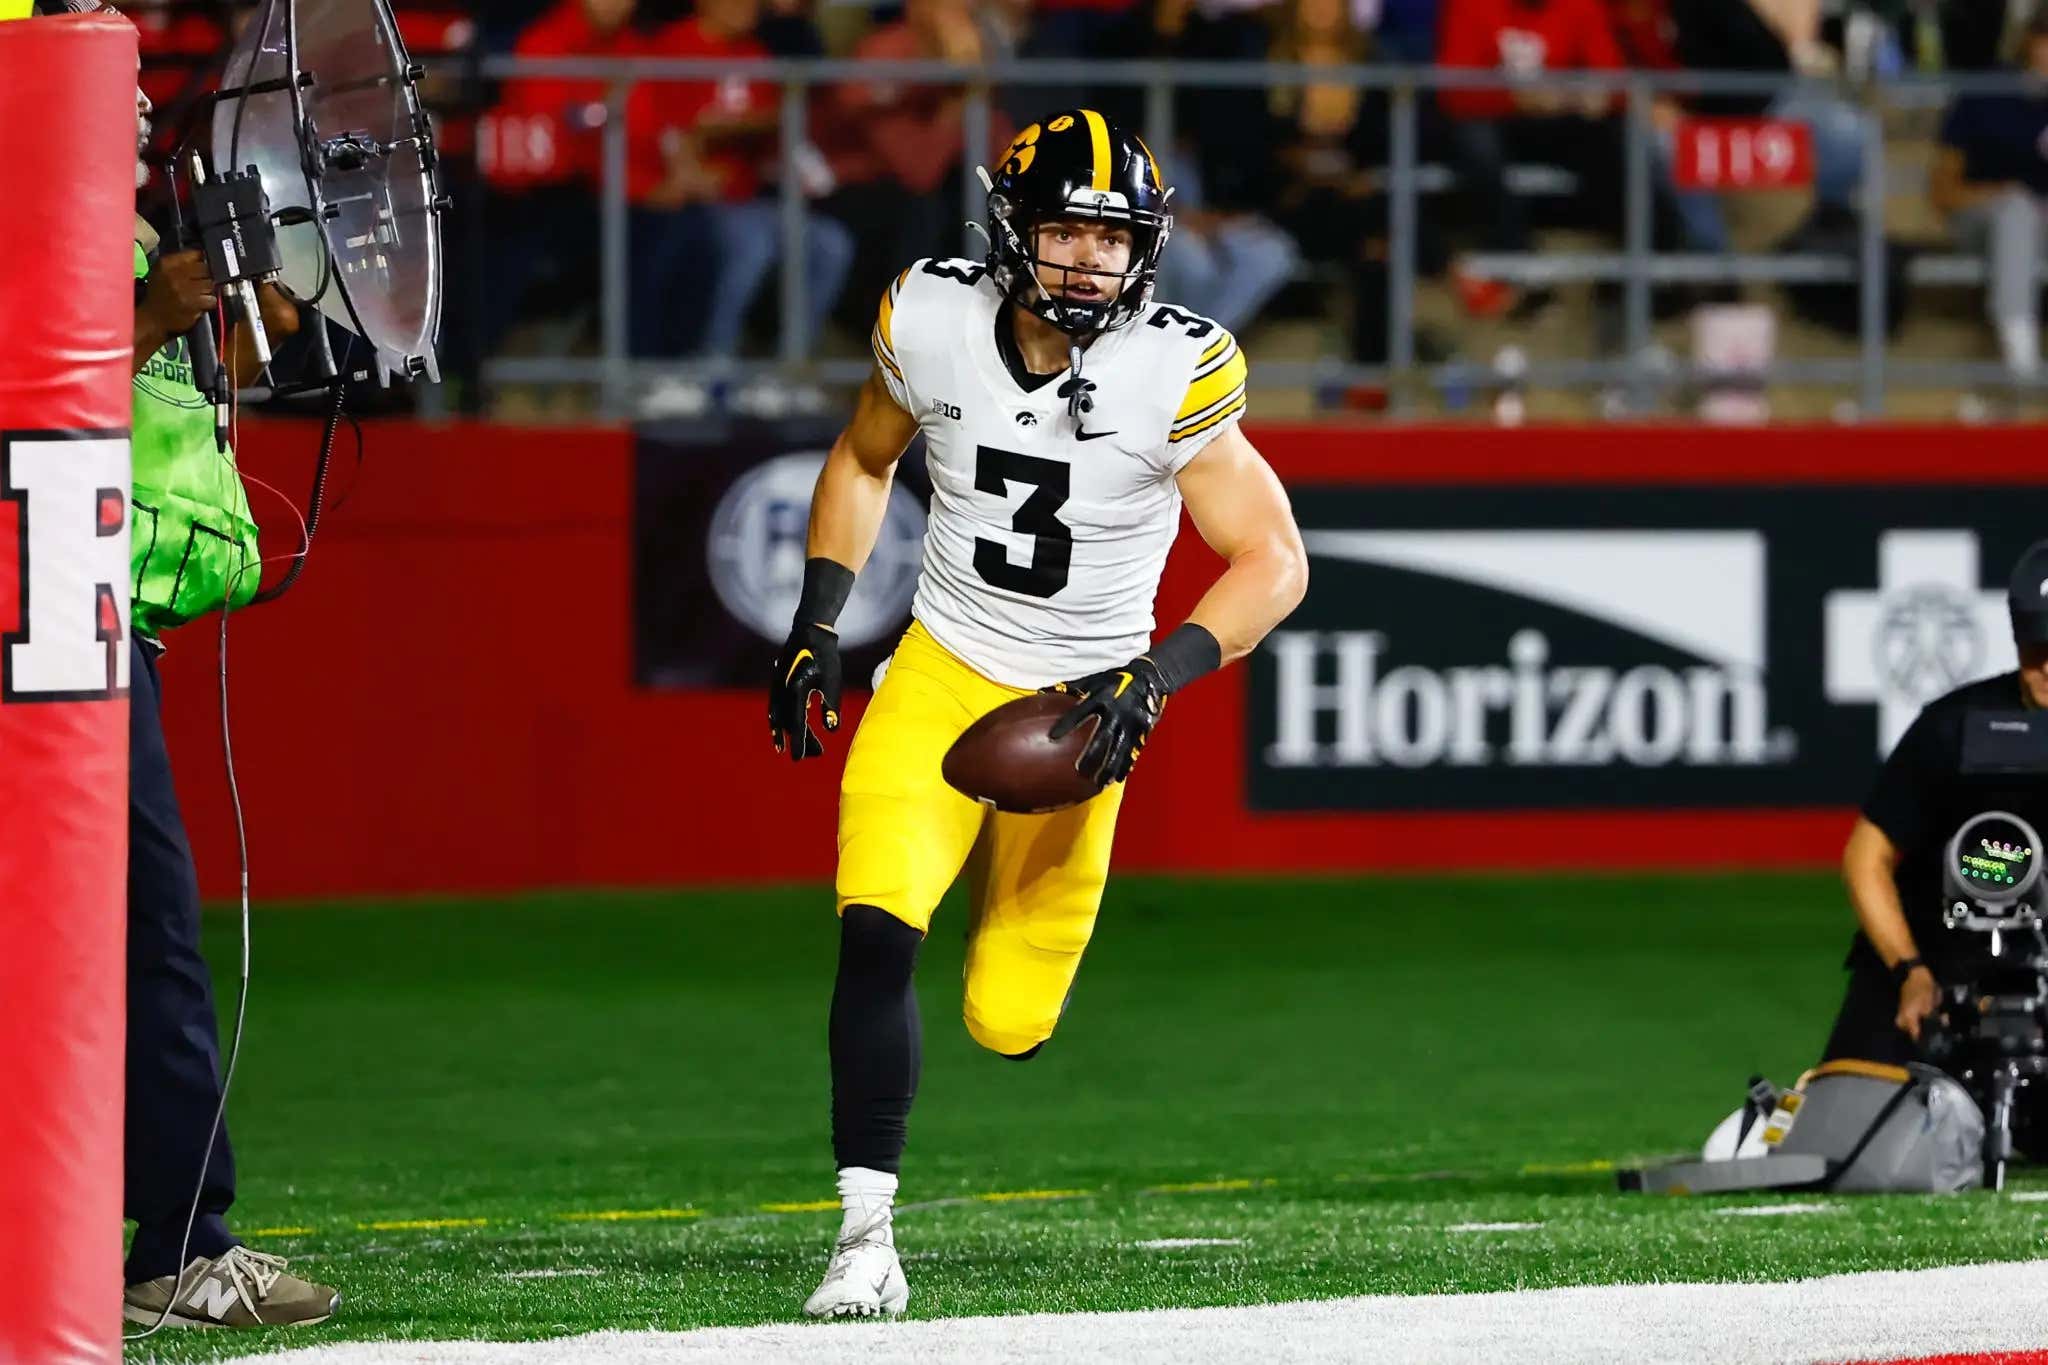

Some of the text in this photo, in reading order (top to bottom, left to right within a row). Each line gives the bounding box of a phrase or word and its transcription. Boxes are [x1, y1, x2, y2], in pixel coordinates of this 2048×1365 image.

[1147, 306, 1214, 338] 3
[972, 444, 1073, 598] 3
[1268, 628, 1772, 768] Horizon
